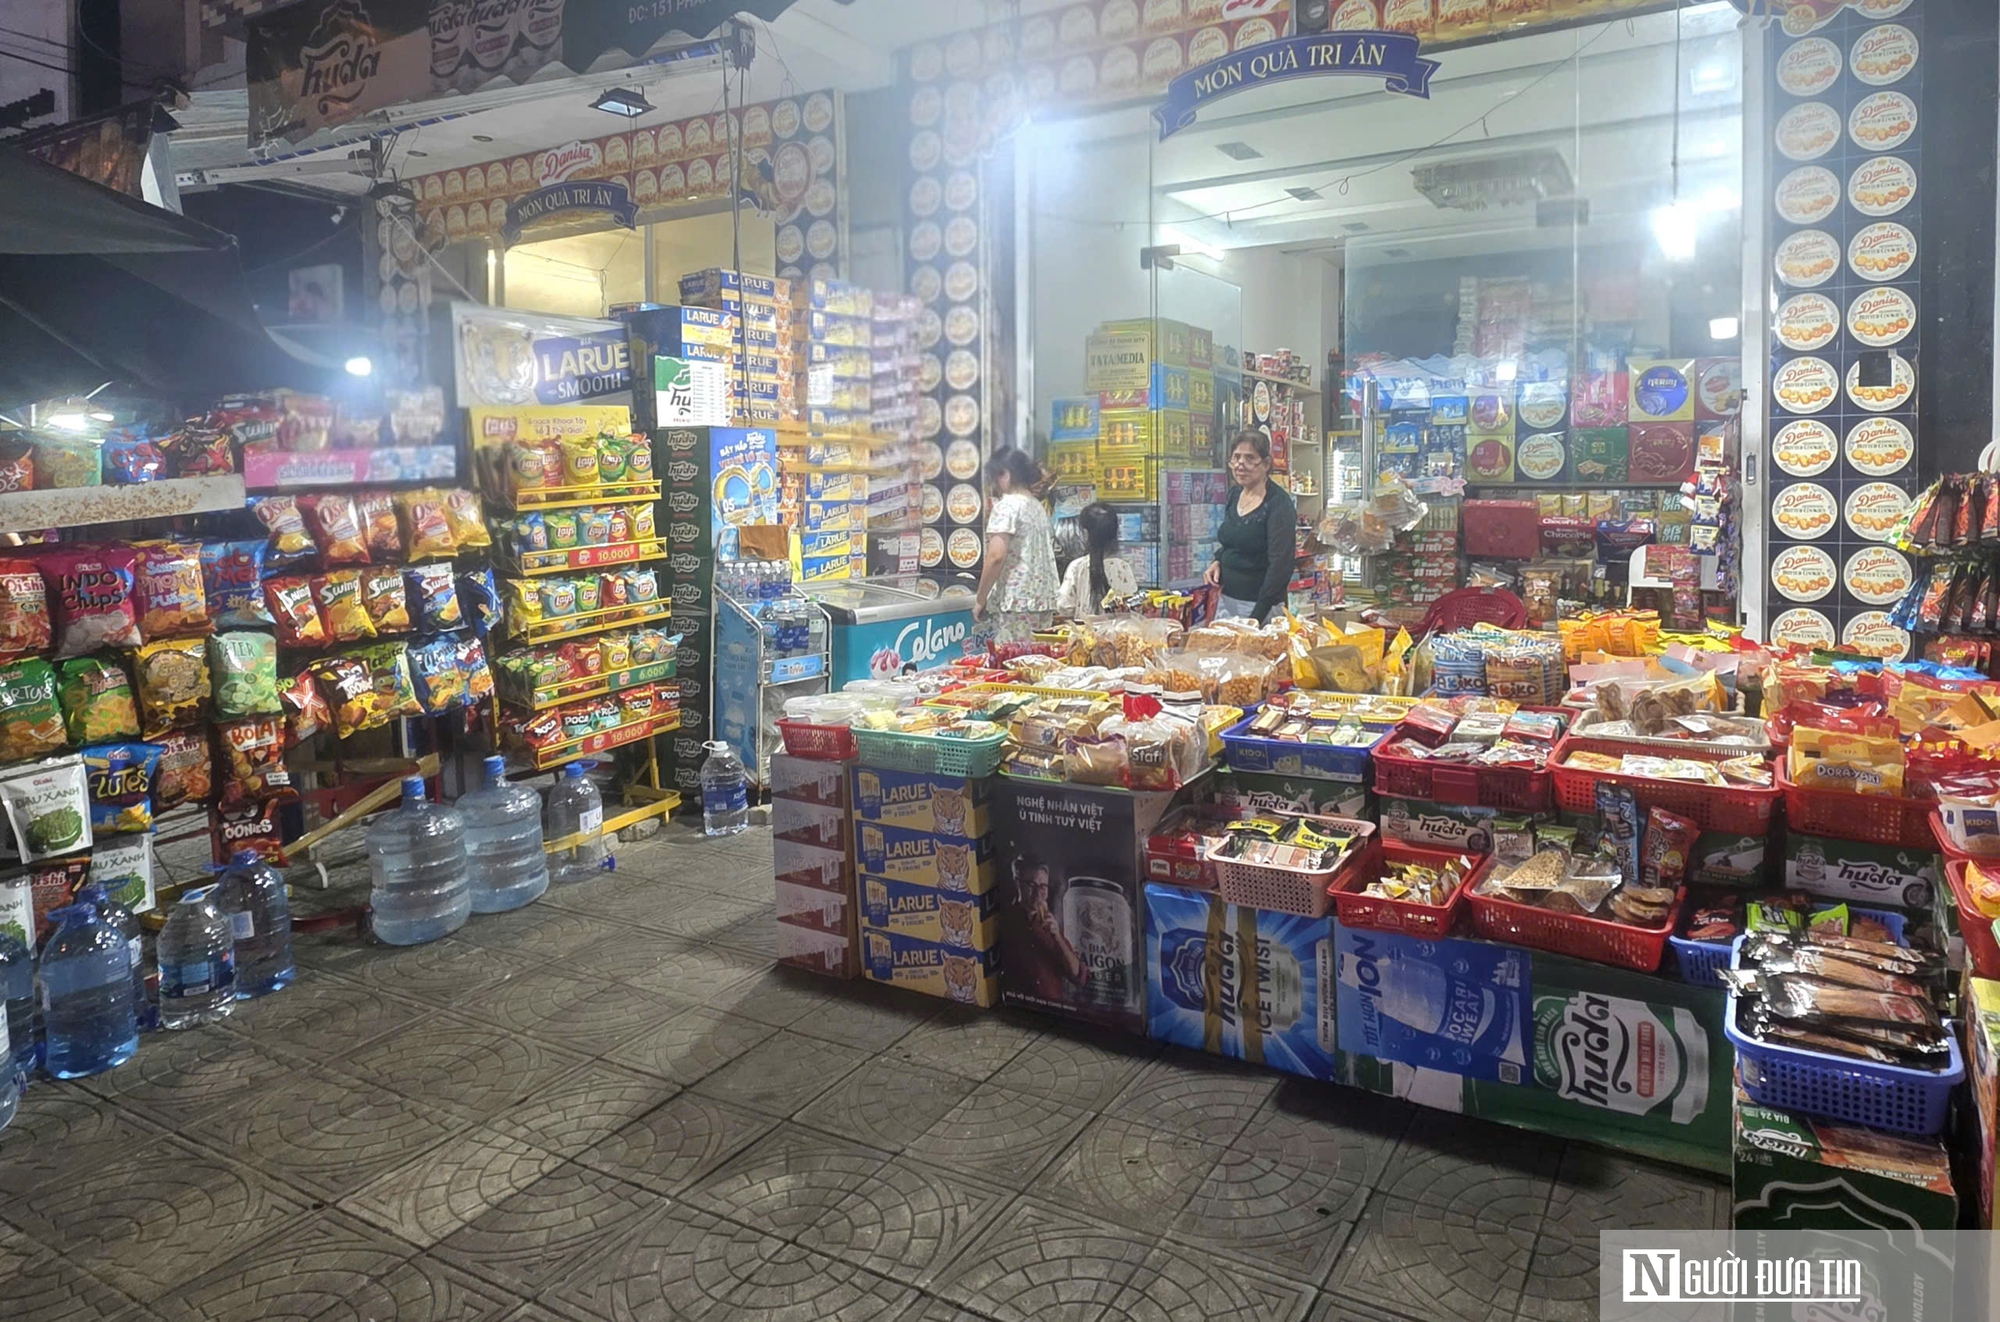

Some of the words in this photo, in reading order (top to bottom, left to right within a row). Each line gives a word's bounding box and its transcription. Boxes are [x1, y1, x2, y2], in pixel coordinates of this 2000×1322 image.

[652, 2, 673, 19] 151
[1859, 33, 1904, 54] Danisa
[301, 41, 381, 97] huda
[1194, 61, 1243, 99] MÓN
[1251, 45, 1299, 78] QUÀ
[1307, 43, 1342, 67] TRI
[1349, 38, 1387, 67] ÂN
[1858, 100, 1903, 120] Danisa
[542, 144, 593, 181] Danisa
[1857, 166, 1902, 185] Danisa
[518, 202, 543, 223] MÓN
[545, 191, 570, 211] QUÀ
[572, 189, 590, 205] TRI
[595, 189, 612, 206] ÂN
[1857, 232, 1902, 250] Danisa
[1783, 303, 1826, 320] Danisa
[1856, 297, 1902, 315] Danisa
[686, 310, 719, 325] LARUE
[542, 342, 630, 381] LARUE
[1782, 367, 1825, 383] Danisa
[557, 372, 621, 399] SMOOTH
[668, 431, 697, 446] huda
[1781, 430, 1823, 446] Danisa
[1855, 428, 1899, 444] Danisa
[669, 462, 698, 477] huda
[824, 474, 848, 487] LARUE
[669, 493, 699, 508] huda
[1780, 492, 1823, 508] Danisa
[1855, 492, 1899, 508] Danisa
[823, 503, 849, 519] LARUE
[670, 523, 700, 538] huda
[1543, 529, 1592, 540] ChocoPie
[820, 531, 848, 548] LARUE
[671, 554, 701, 569] huda
[820, 556, 848, 572] LARUE
[1780, 556, 1823, 571] Danisa
[1854, 558, 1897, 573] Danisa
[4, 577, 45, 594] Oishi
[60, 570, 119, 591] INDO
[367, 574, 404, 599] Swing
[421, 574, 453, 598] Swing
[320, 576, 360, 604] Swing
[672, 585, 701, 599] huda
[62, 591, 126, 611] Chips
[671, 618, 700, 632] huda
[1779, 618, 1821, 634] Danisa
[895, 618, 965, 664] Celano
[661, 691, 680, 700] POCA
[534, 719, 557, 736] POCA
[565, 714, 589, 725] POCA
[231, 722, 273, 747] BOLA
[675, 740, 701, 754] huda
[44, 787, 81, 803] XANH
[882, 782, 927, 802] LARUE
[1248, 790, 1290, 811] huda
[1017, 795, 1045, 810] NGHỆ
[1047, 799, 1078, 814] NHÂN
[1080, 802, 1104, 817] VIỆT
[1028, 811, 1053, 825] TINH
[1078, 818, 1102, 834] VIỆT
[1418, 813, 1468, 840] huda
[886, 838, 931, 858] LARUE
[110, 852, 146, 868] XANH
[1838, 859, 1904, 890] huda
[889, 894, 935, 912] LARUE
[893, 949, 938, 966] LARUE
[1088, 943, 1106, 955] BIA
[1080, 953, 1126, 969] AIGON
[1256, 937, 1272, 995] TWIST
[1352, 934, 1382, 998] ION
[1256, 1000, 1272, 1036] ICE
[1446, 980, 1468, 1041] POCARI
[1457, 987, 1480, 1045] SWEAT
[1562, 994, 1610, 1107] huda
[1760, 1111, 1772, 1120] 24
[1774, 1113, 1790, 1124] BIA
